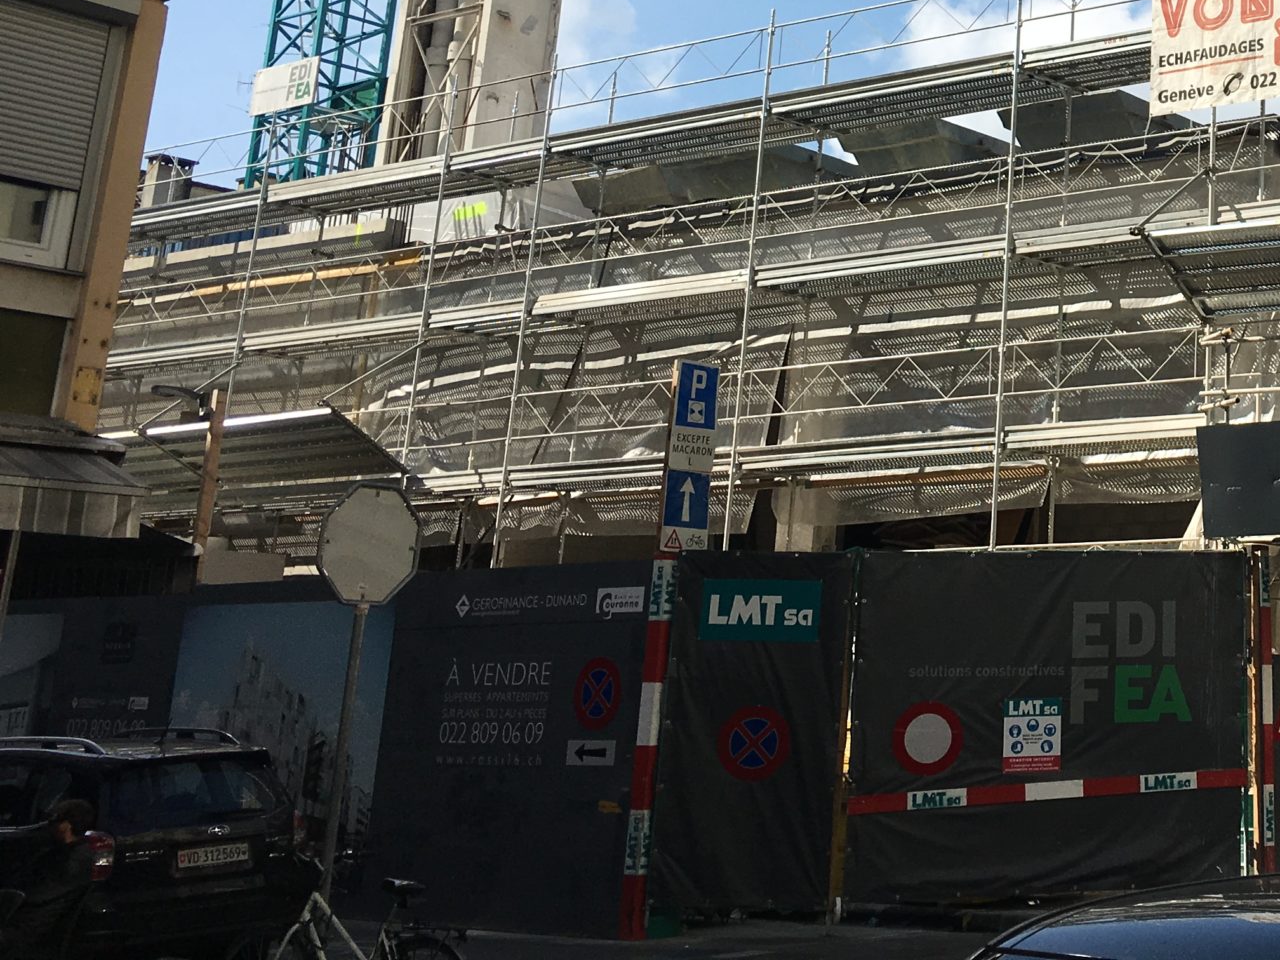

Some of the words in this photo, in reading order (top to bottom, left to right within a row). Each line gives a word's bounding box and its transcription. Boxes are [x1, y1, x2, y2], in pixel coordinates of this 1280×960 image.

[1158, 38, 1264, 69] ECHAFAUDAGES
[289, 61, 313, 84] EDI
[286, 80, 311, 102] FEA
[1158, 83, 1214, 104] Genève
[1250, 71, 1277, 90] 022
[690, 369, 708, 400] P
[676, 432, 711, 445] EXCEPTE
[672, 444, 713, 457] MACARON
[687, 456, 693, 466] L
[471, 596, 539, 610] GEROFINANCE
[546, 593, 588, 608] DUNAND
[650, 580, 663, 616] LMT
[708, 594, 783, 626] LMT
[784, 608, 814, 626] sa
[1072, 600, 1176, 659] EDI
[446, 657, 460, 686] À
[472, 662, 552, 686] VENDRE
[908, 664, 972, 678] solutions
[976, 664, 1065, 678] constructives
[1070, 664, 1192, 724] FEA
[1008, 700, 1043, 716] LMT
[1043, 705, 1058, 715] sa
[440, 722, 467, 744] 022
[471, 722, 498, 744] 809
[502, 722, 521, 744] 06
[525, 722, 544, 744] 09
[1144, 775, 1176, 791] LMT
[1177, 778, 1191, 790] sa
[912, 792, 946, 808] LMT
[946, 795, 961, 807] sa
[1265, 807, 1274, 843] LMT
[626, 833, 638, 871] LMT
